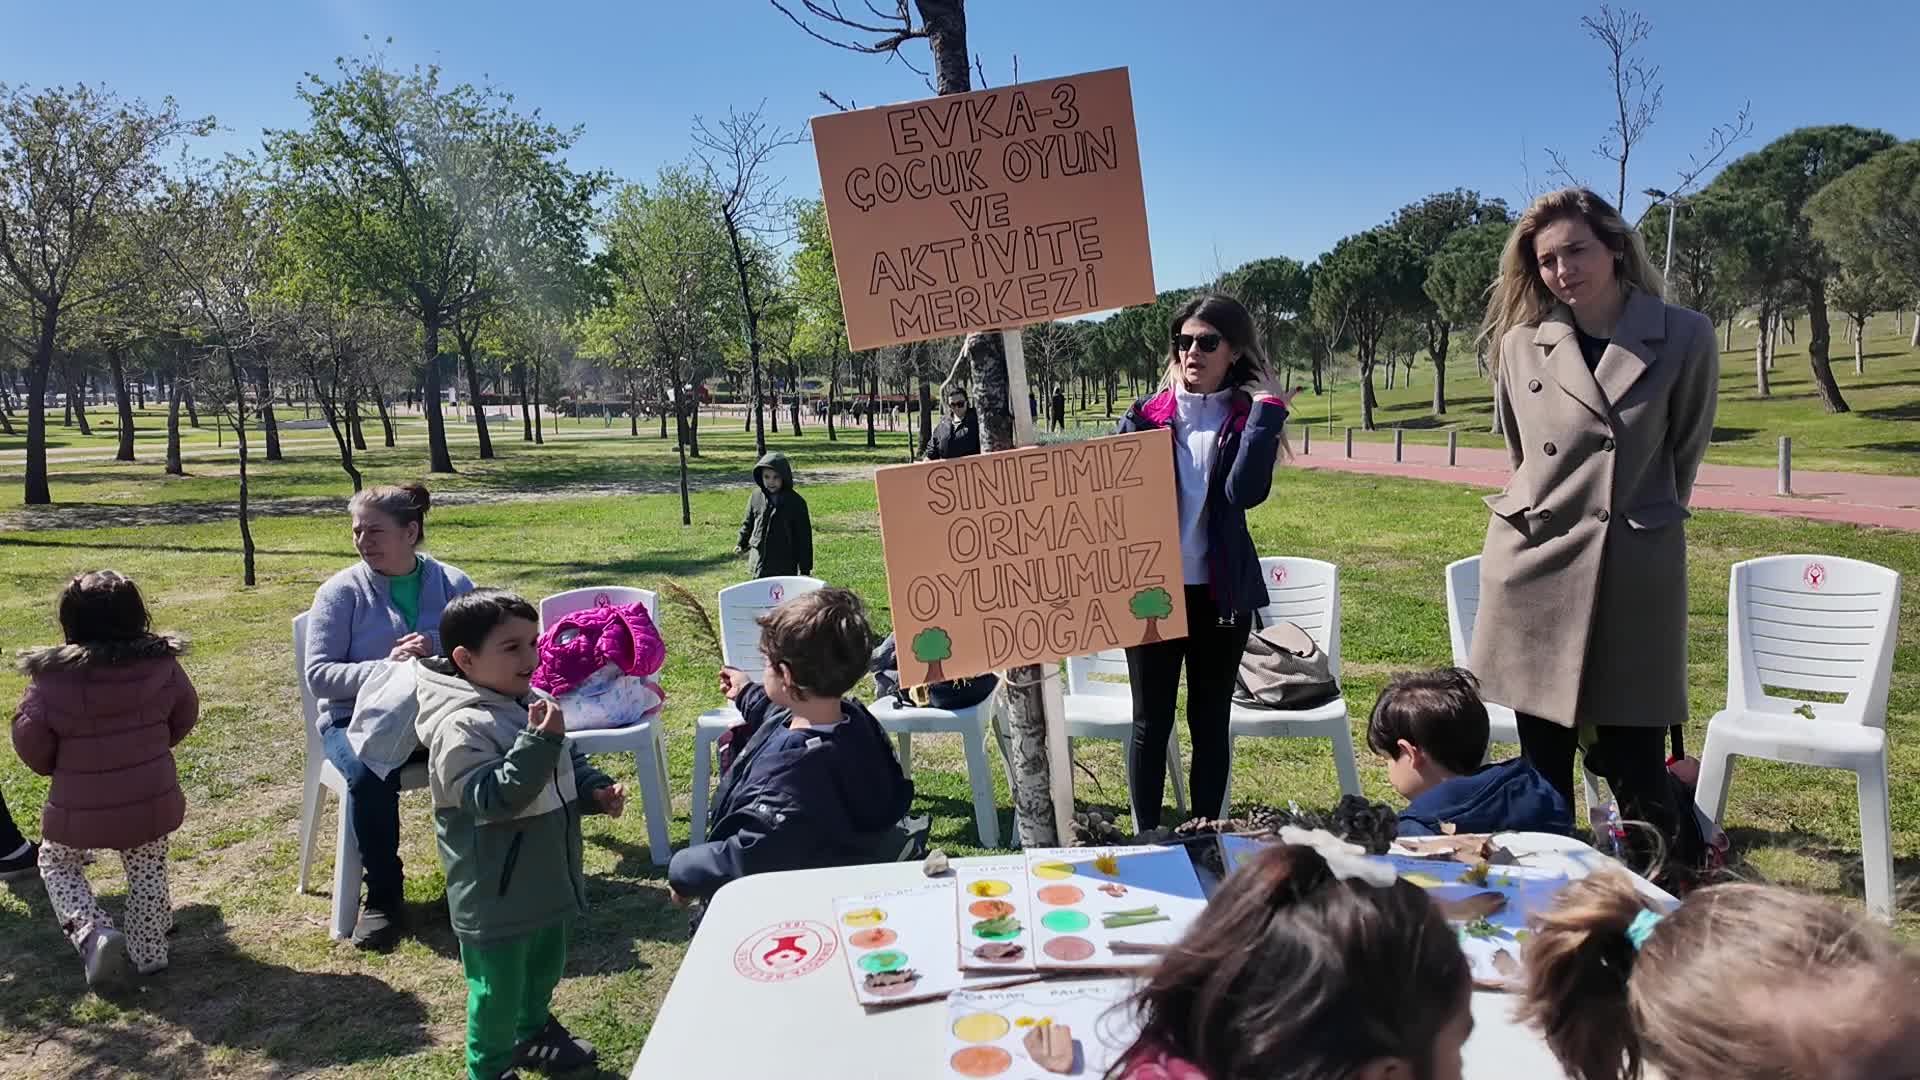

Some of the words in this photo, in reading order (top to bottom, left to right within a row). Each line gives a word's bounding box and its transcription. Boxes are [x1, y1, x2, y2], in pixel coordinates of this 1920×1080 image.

[888, 83, 1080, 155] EVKA-3
[845, 148, 988, 212] ÇOCUK
[1003, 125, 1118, 183] OYUN
[950, 193, 1010, 232] VE
[869, 216, 1103, 295] AKTİVİTE
[890, 263, 1099, 337] MERKEZİ
[927, 439, 1143, 515] SINIFIMIZ
[948, 495, 1126, 563] ORMAN
[907, 541, 1165, 622] OYUNUMUZ
[983, 598, 1119, 668] DOĞA
